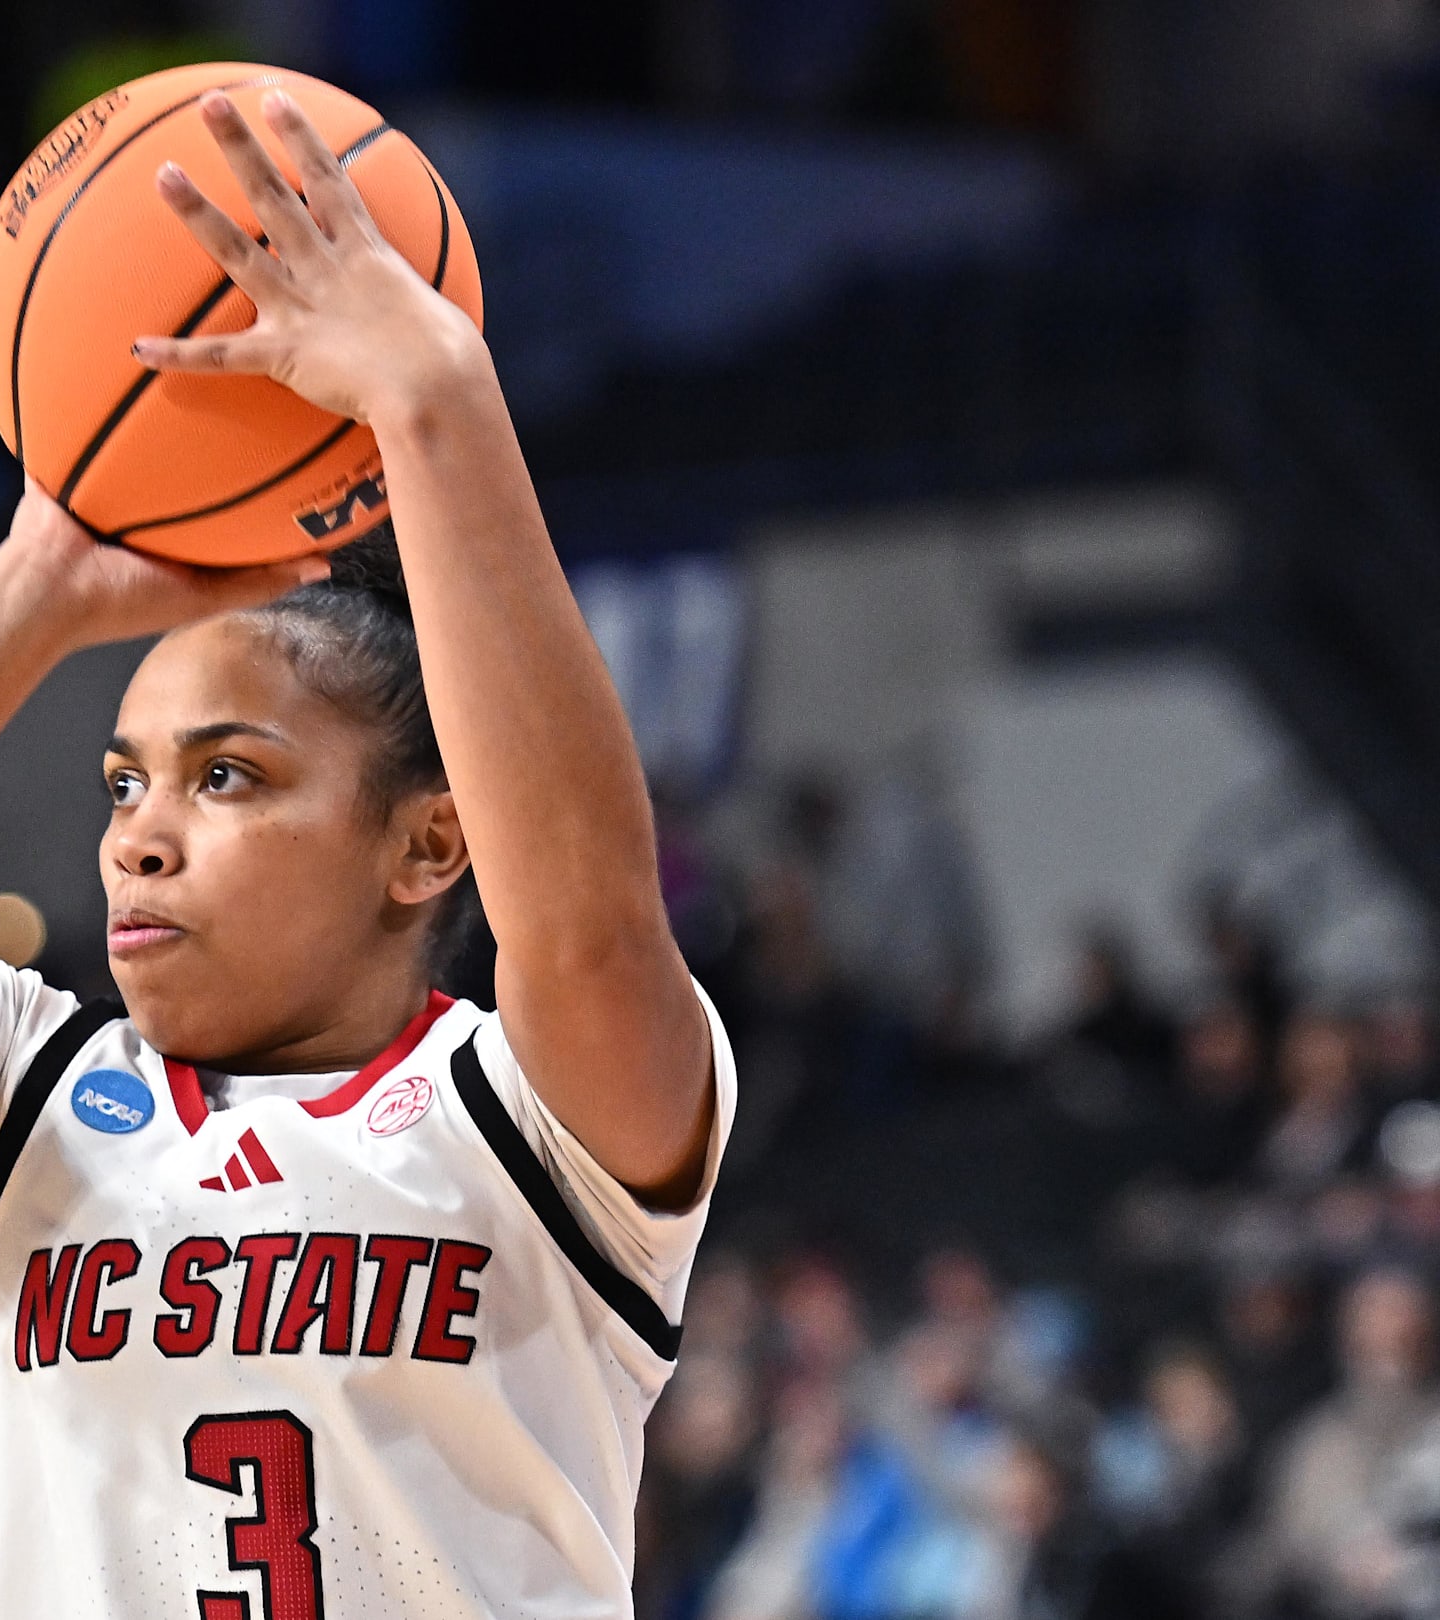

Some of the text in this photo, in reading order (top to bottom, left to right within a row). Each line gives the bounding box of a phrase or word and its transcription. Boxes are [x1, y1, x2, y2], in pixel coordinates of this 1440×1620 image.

[78, 1088, 144, 1127] NCAA
[373, 1084, 428, 1122] ACC
[14, 1232, 493, 1372] NC STATE
[182, 1409, 325, 1620] 3
